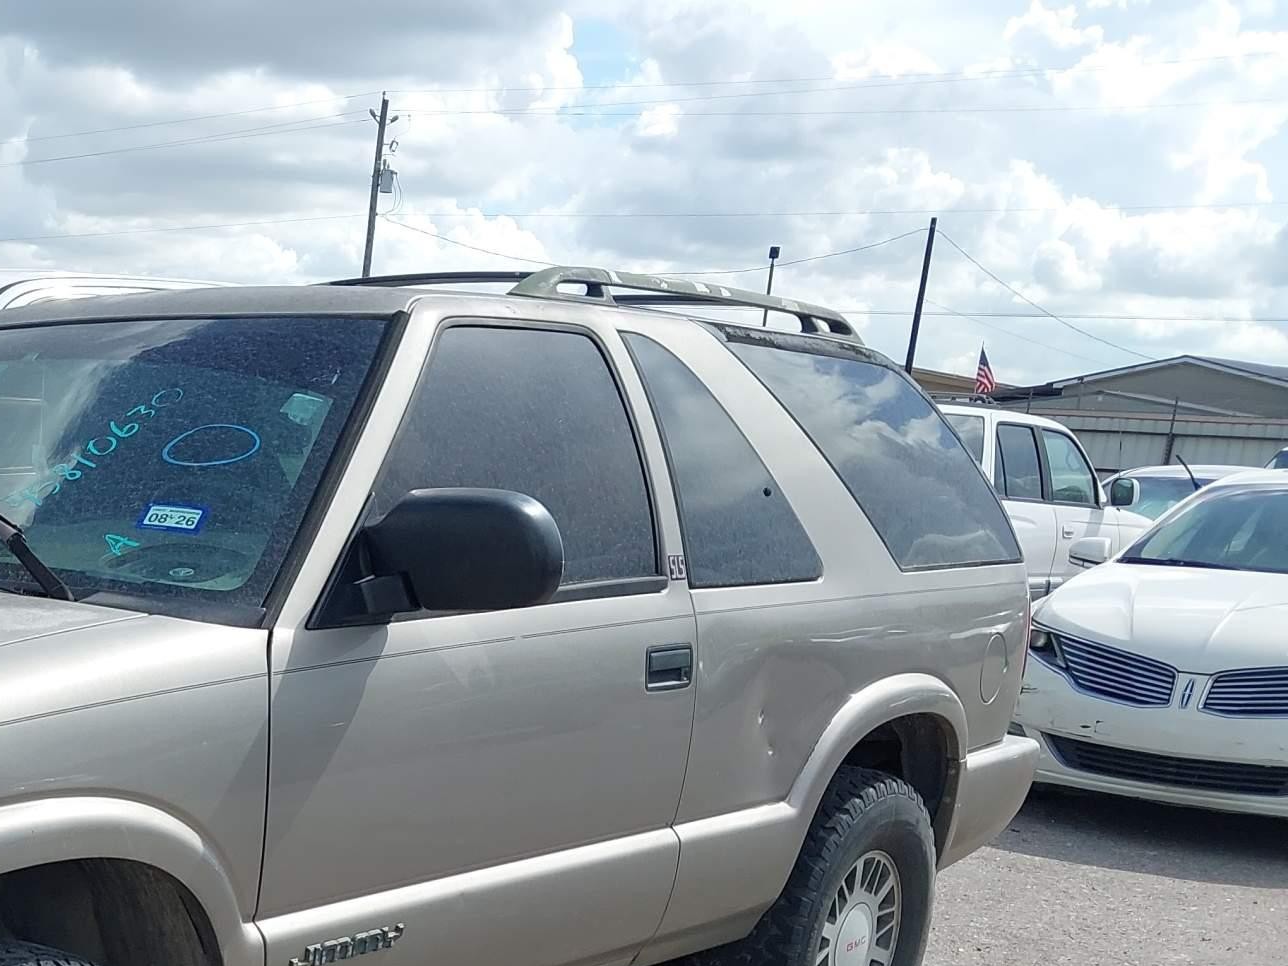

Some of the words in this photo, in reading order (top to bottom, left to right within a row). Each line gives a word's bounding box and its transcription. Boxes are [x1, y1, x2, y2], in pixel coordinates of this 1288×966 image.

[148, 513, 168, 523] 08
[174, 515, 196, 526] 26
[846, 936, 866, 952] GMC
